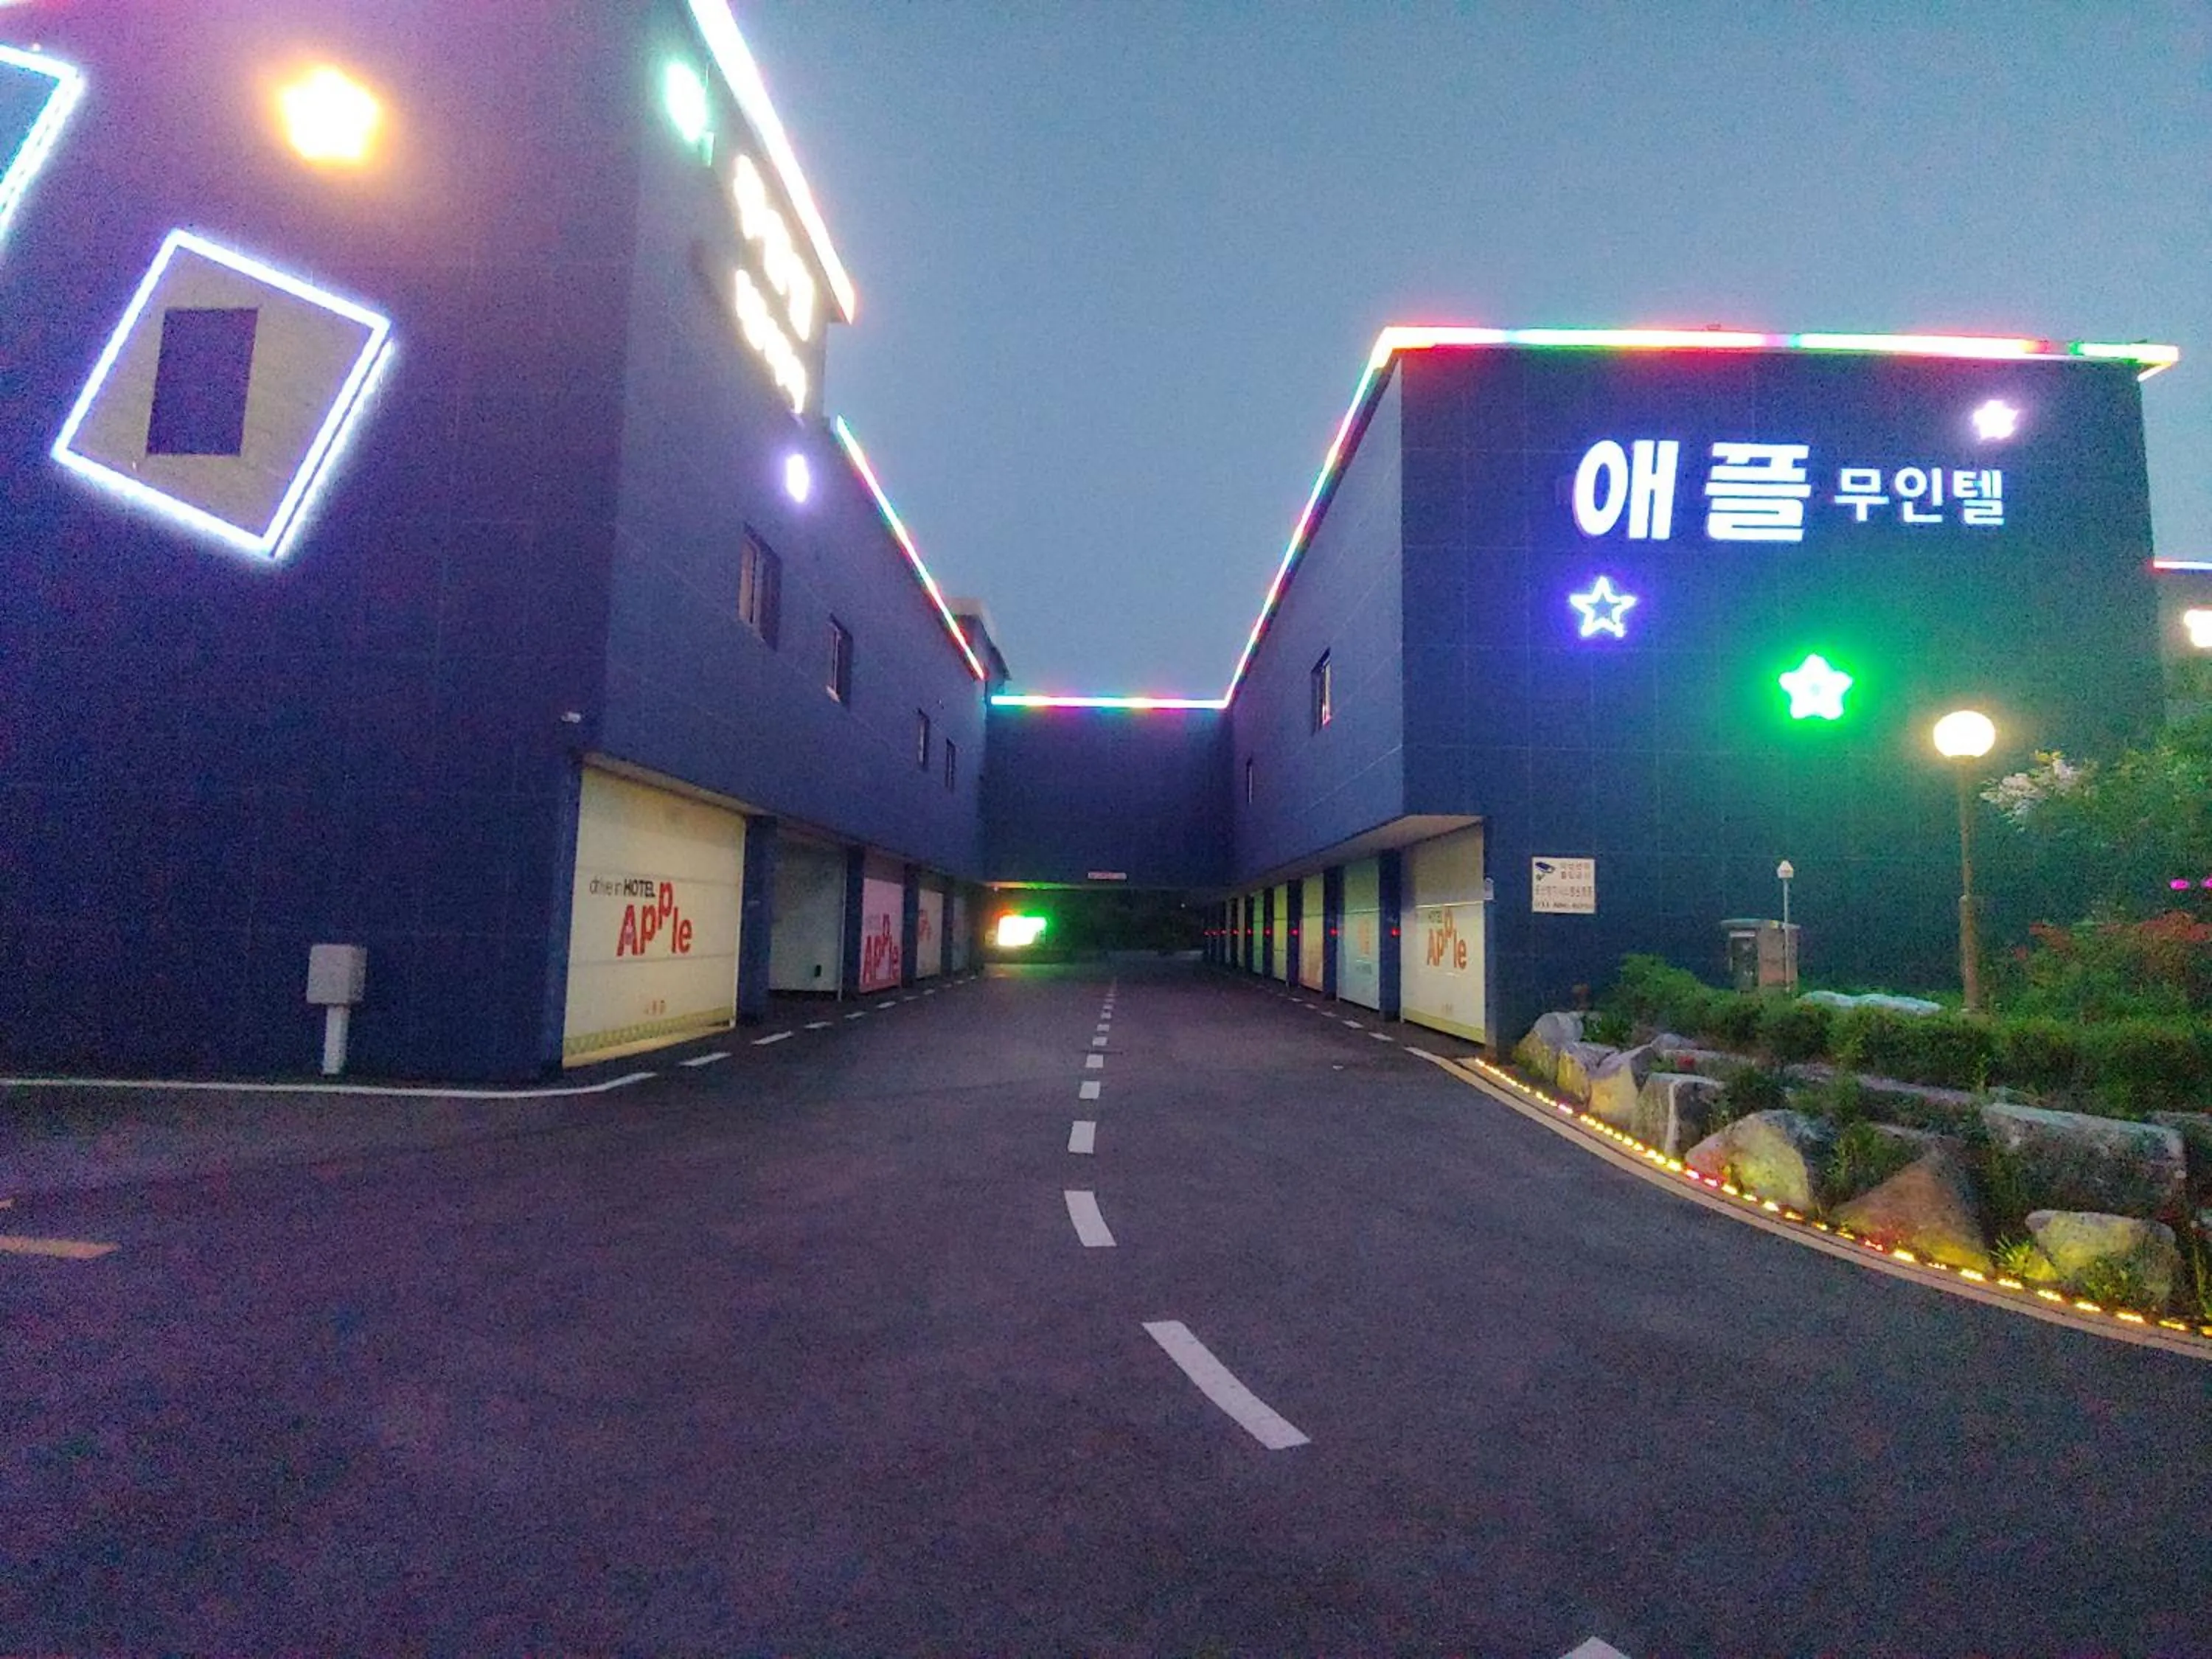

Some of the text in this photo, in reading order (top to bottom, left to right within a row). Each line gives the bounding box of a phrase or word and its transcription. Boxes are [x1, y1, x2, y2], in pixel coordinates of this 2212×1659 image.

[1573, 440, 2004, 541] 애플 무인텔
[616, 881, 692, 956] Apple
[623, 878, 656, 897] HOTEL
[863, 913, 899, 983] Apple
[1427, 907, 1467, 970] Apple
